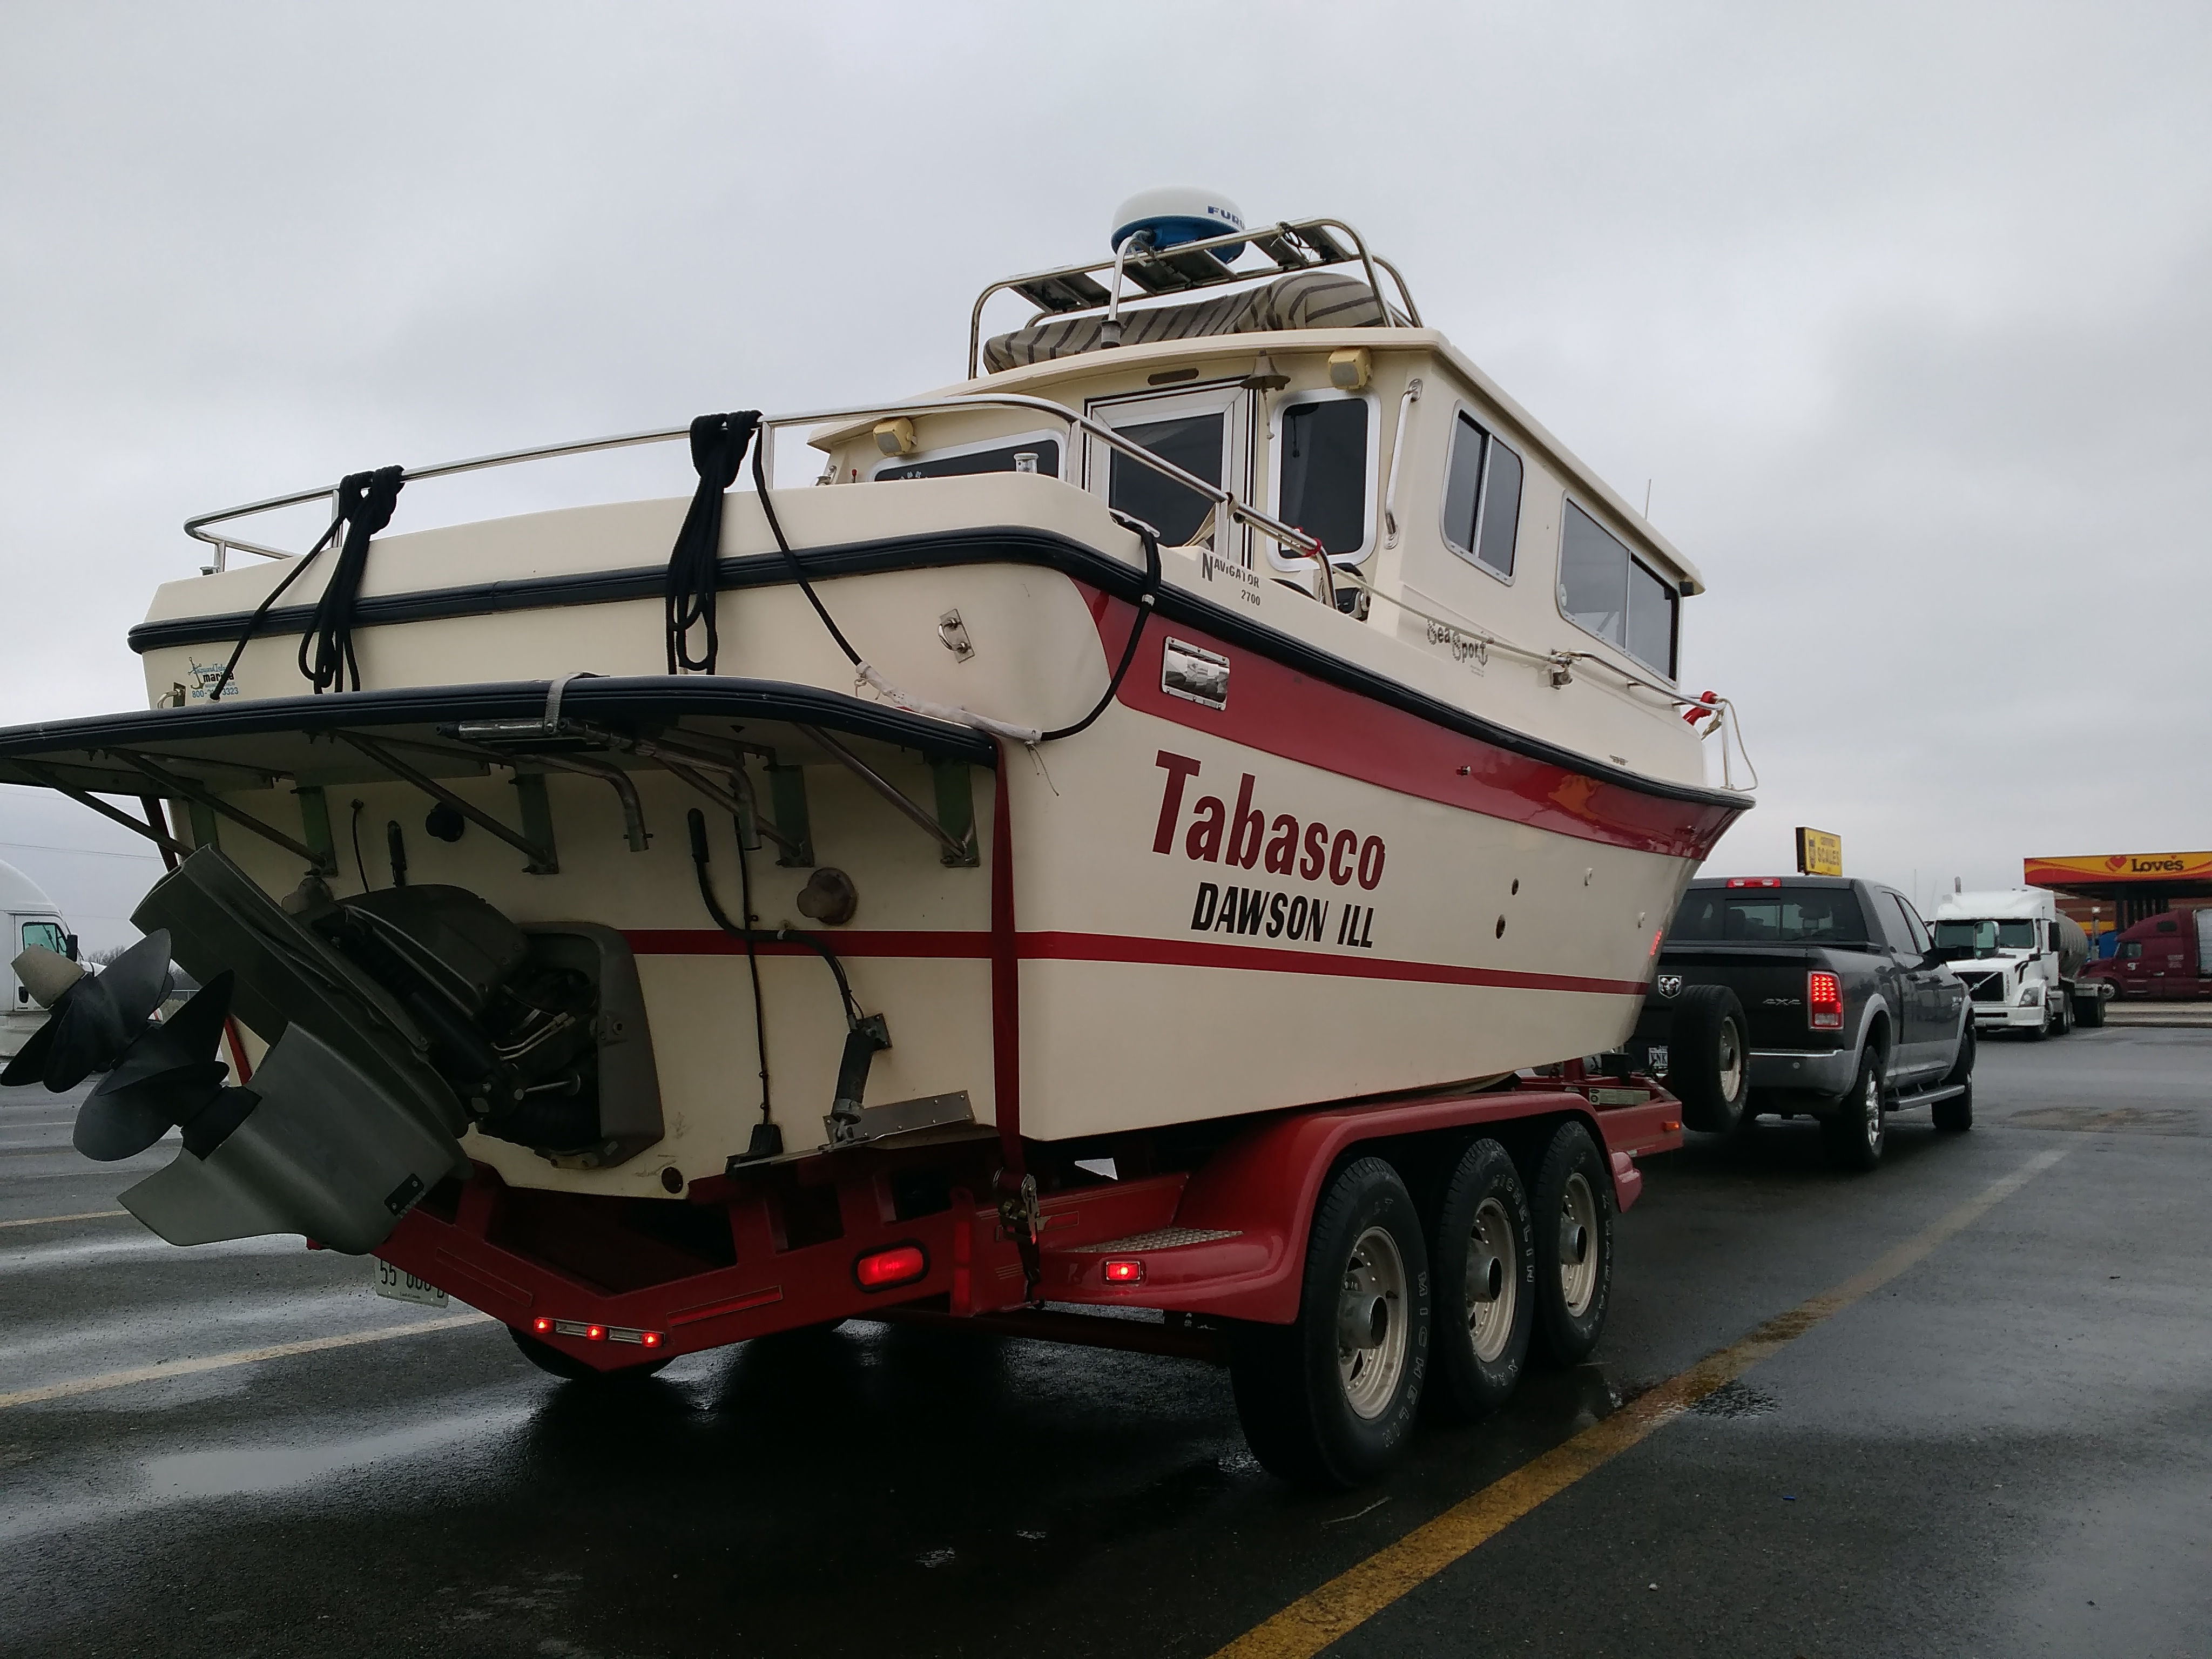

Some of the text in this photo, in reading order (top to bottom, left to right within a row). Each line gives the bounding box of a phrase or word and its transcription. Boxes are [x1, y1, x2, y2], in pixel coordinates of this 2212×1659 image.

[1208, 205, 1245, 230] FURU
[1202, 552, 1260, 589] NAVIGATOR
[1241, 589, 1261, 606] 2700
[1152, 749, 1385, 891] Tabasco
[1190, 881, 1374, 948] DAWSON ILL
[1382, 1270, 1428, 1448] MICHELIN
